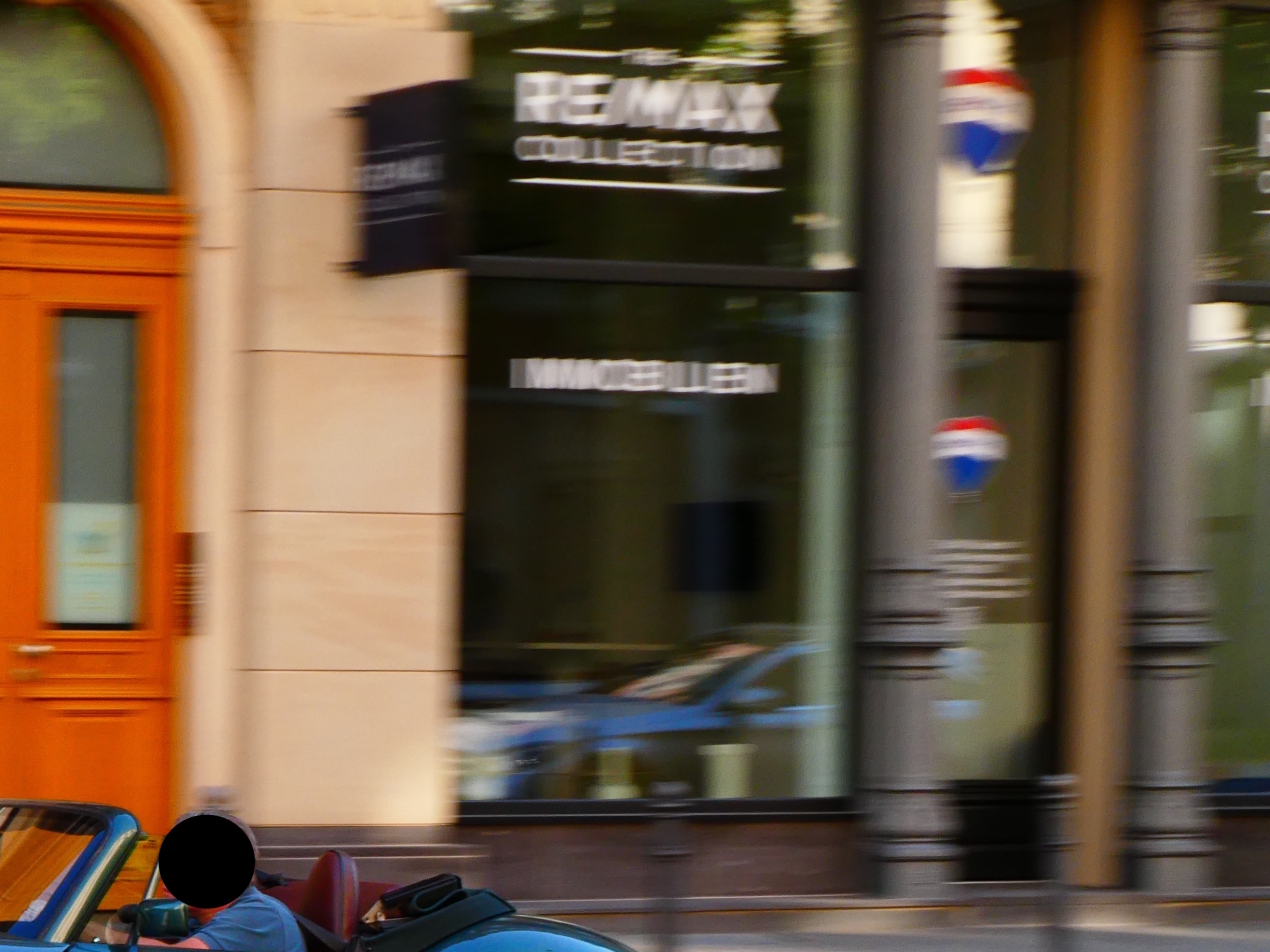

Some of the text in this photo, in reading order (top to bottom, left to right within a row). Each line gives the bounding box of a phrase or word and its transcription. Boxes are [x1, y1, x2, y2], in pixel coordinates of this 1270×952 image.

[514, 72, 782, 133] RE/MAX
[514, 135, 782, 171] COLLECTION
[511, 358, 780, 394] IMMOBILIEN
